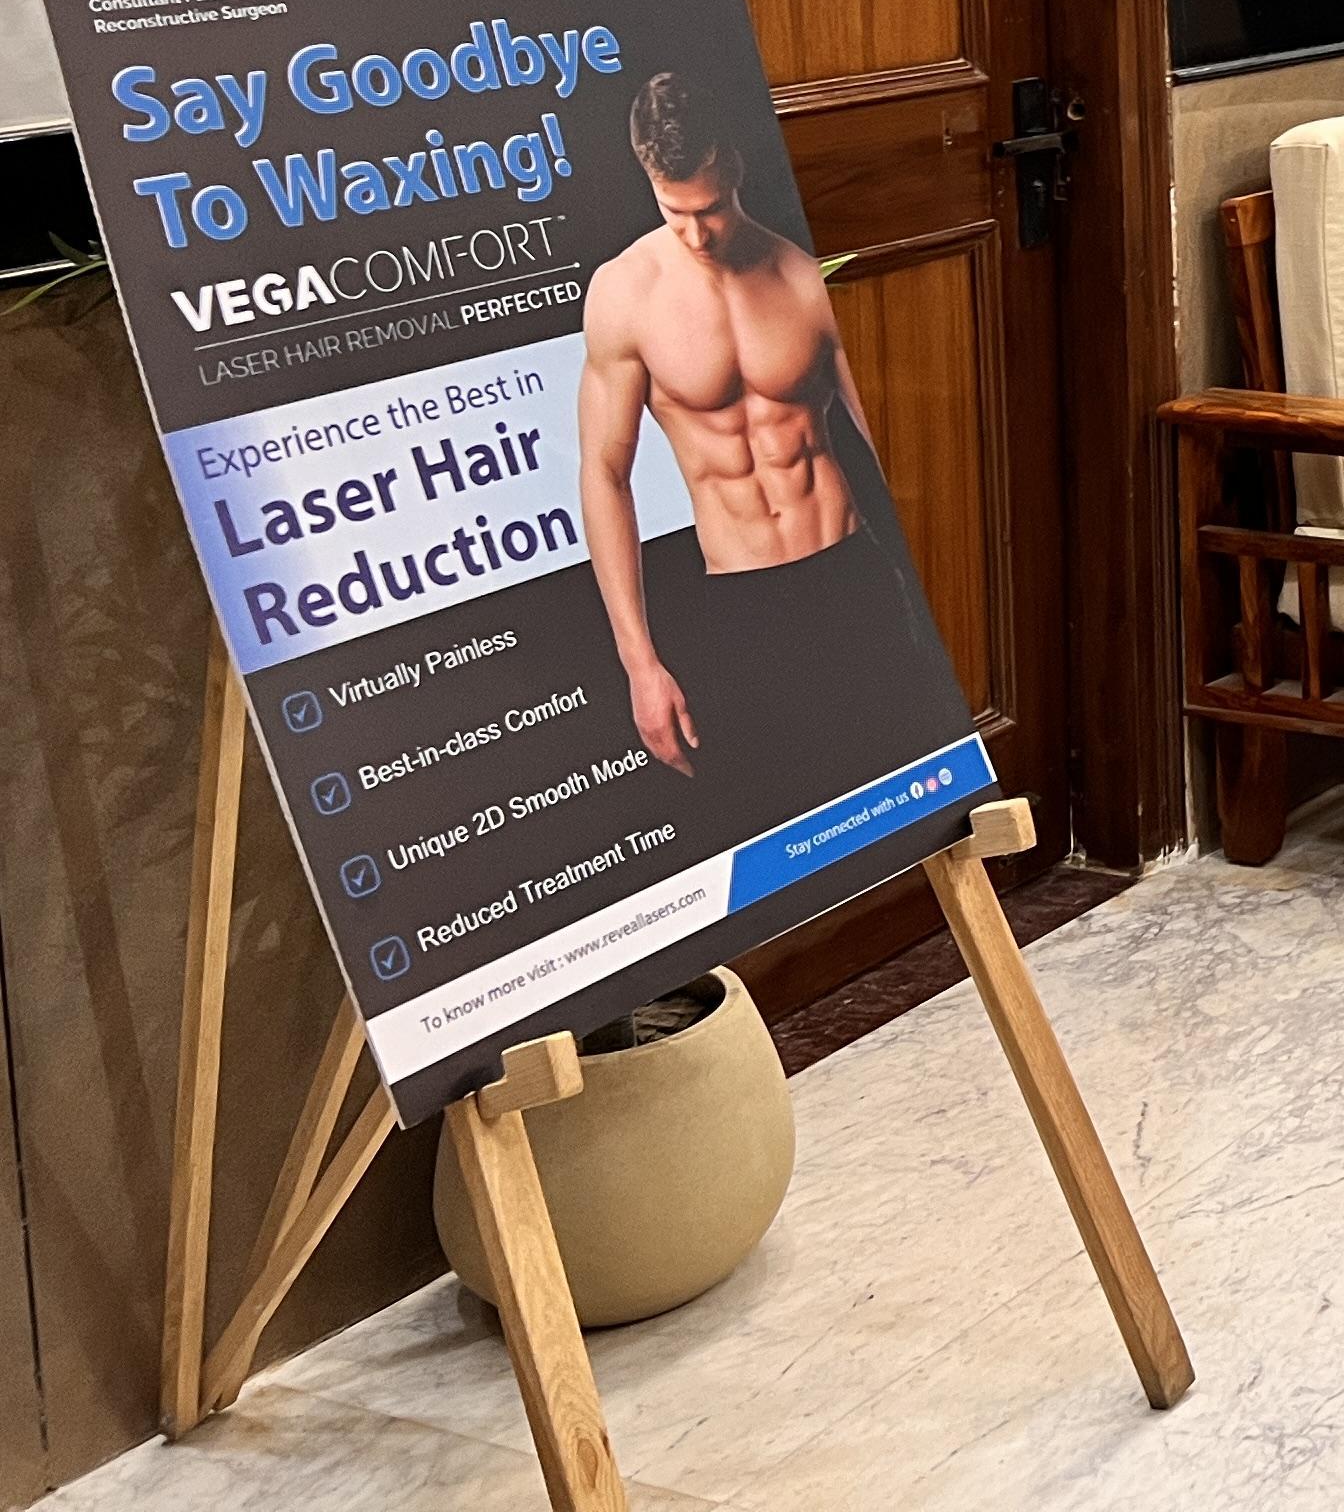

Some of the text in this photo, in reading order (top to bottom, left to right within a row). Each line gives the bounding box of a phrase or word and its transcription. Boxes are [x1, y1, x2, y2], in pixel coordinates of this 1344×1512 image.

[94, 2, 288, 33] Reconstructive Surgeon
[110, 17, 623, 148] Say Goodbye
[133, 112, 573, 249] To Waxing!
[198, 279, 582, 387] LASER HAIR REMOVAL PERFECTED
[197, 368, 544, 481] Experience the Best in
[214, 420, 542, 559] Laser Hair
[243, 506, 579, 647] Reduction
[328, 629, 519, 708] Virtually Painless
[357, 685, 588, 790] Best-in-class Comfort
[387, 747, 649, 871] Unique 2D Smooth Mode
[785, 791, 910, 859] Stay connected with us
[416, 822, 676, 952] Reduced Treatment Time
[420, 886, 707, 1034] To know more visit www.reveallasers.com
